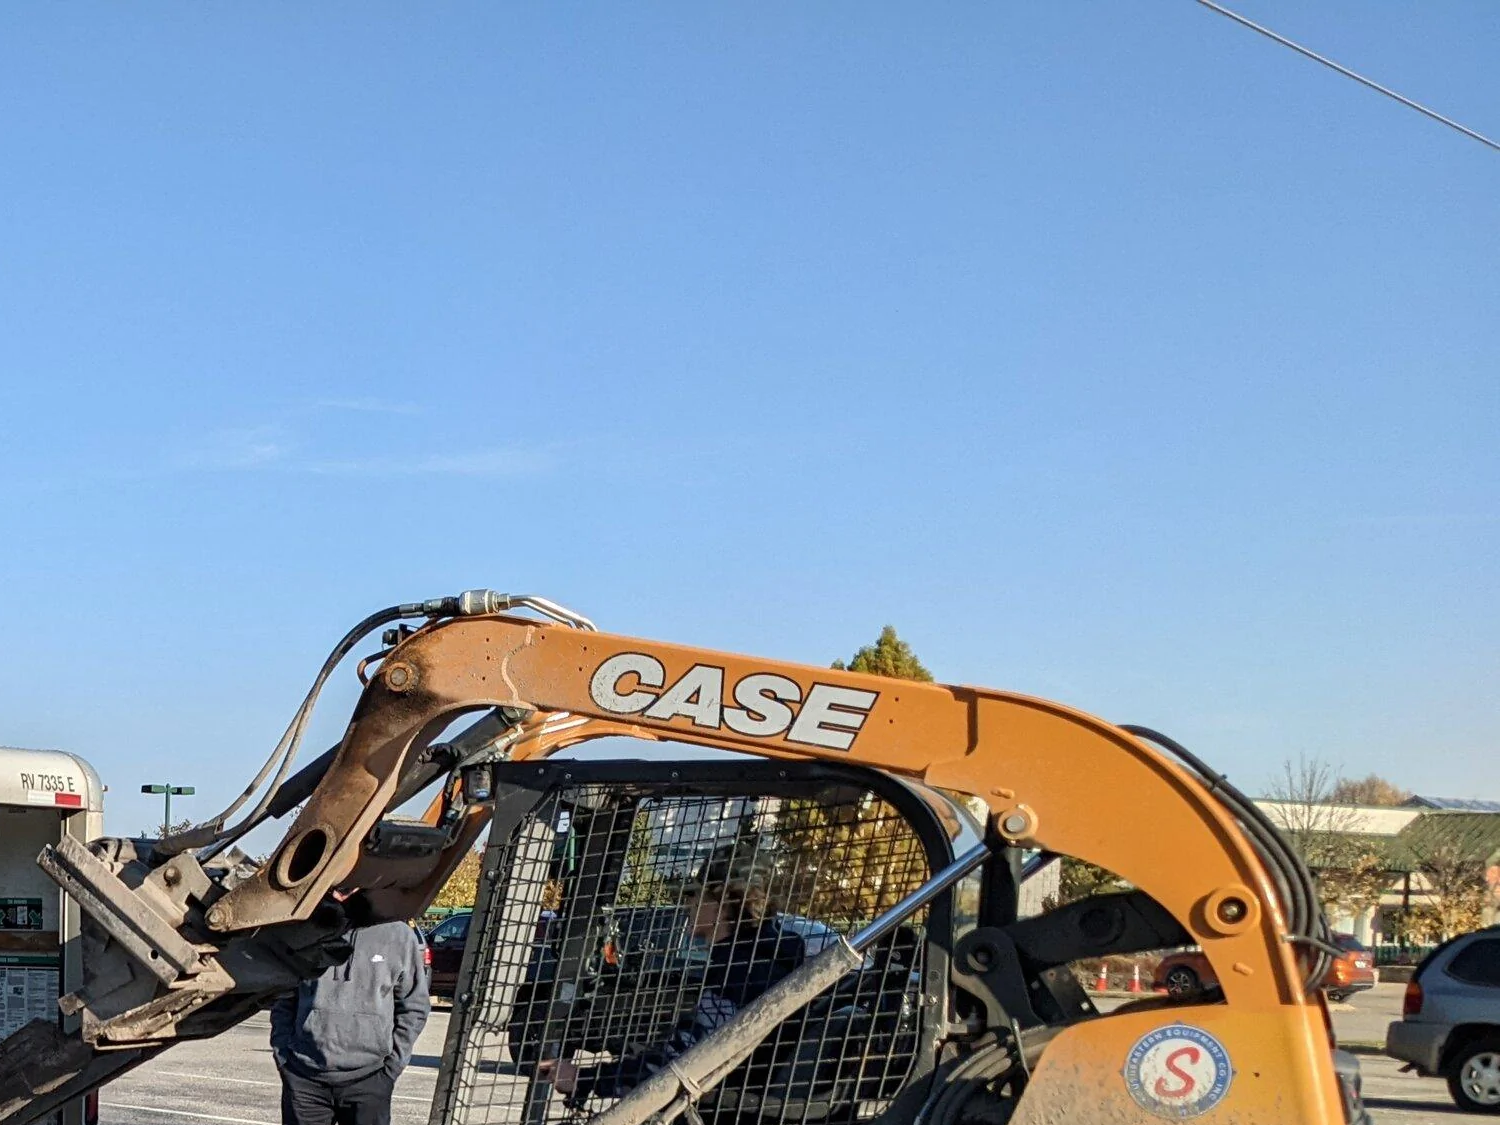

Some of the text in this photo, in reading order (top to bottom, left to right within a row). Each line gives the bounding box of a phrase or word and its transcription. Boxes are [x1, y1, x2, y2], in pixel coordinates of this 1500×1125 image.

[589, 652, 880, 751] CASE
[20, 773, 75, 792] RV 7335 E
[1154, 1046, 1200, 1098] S
